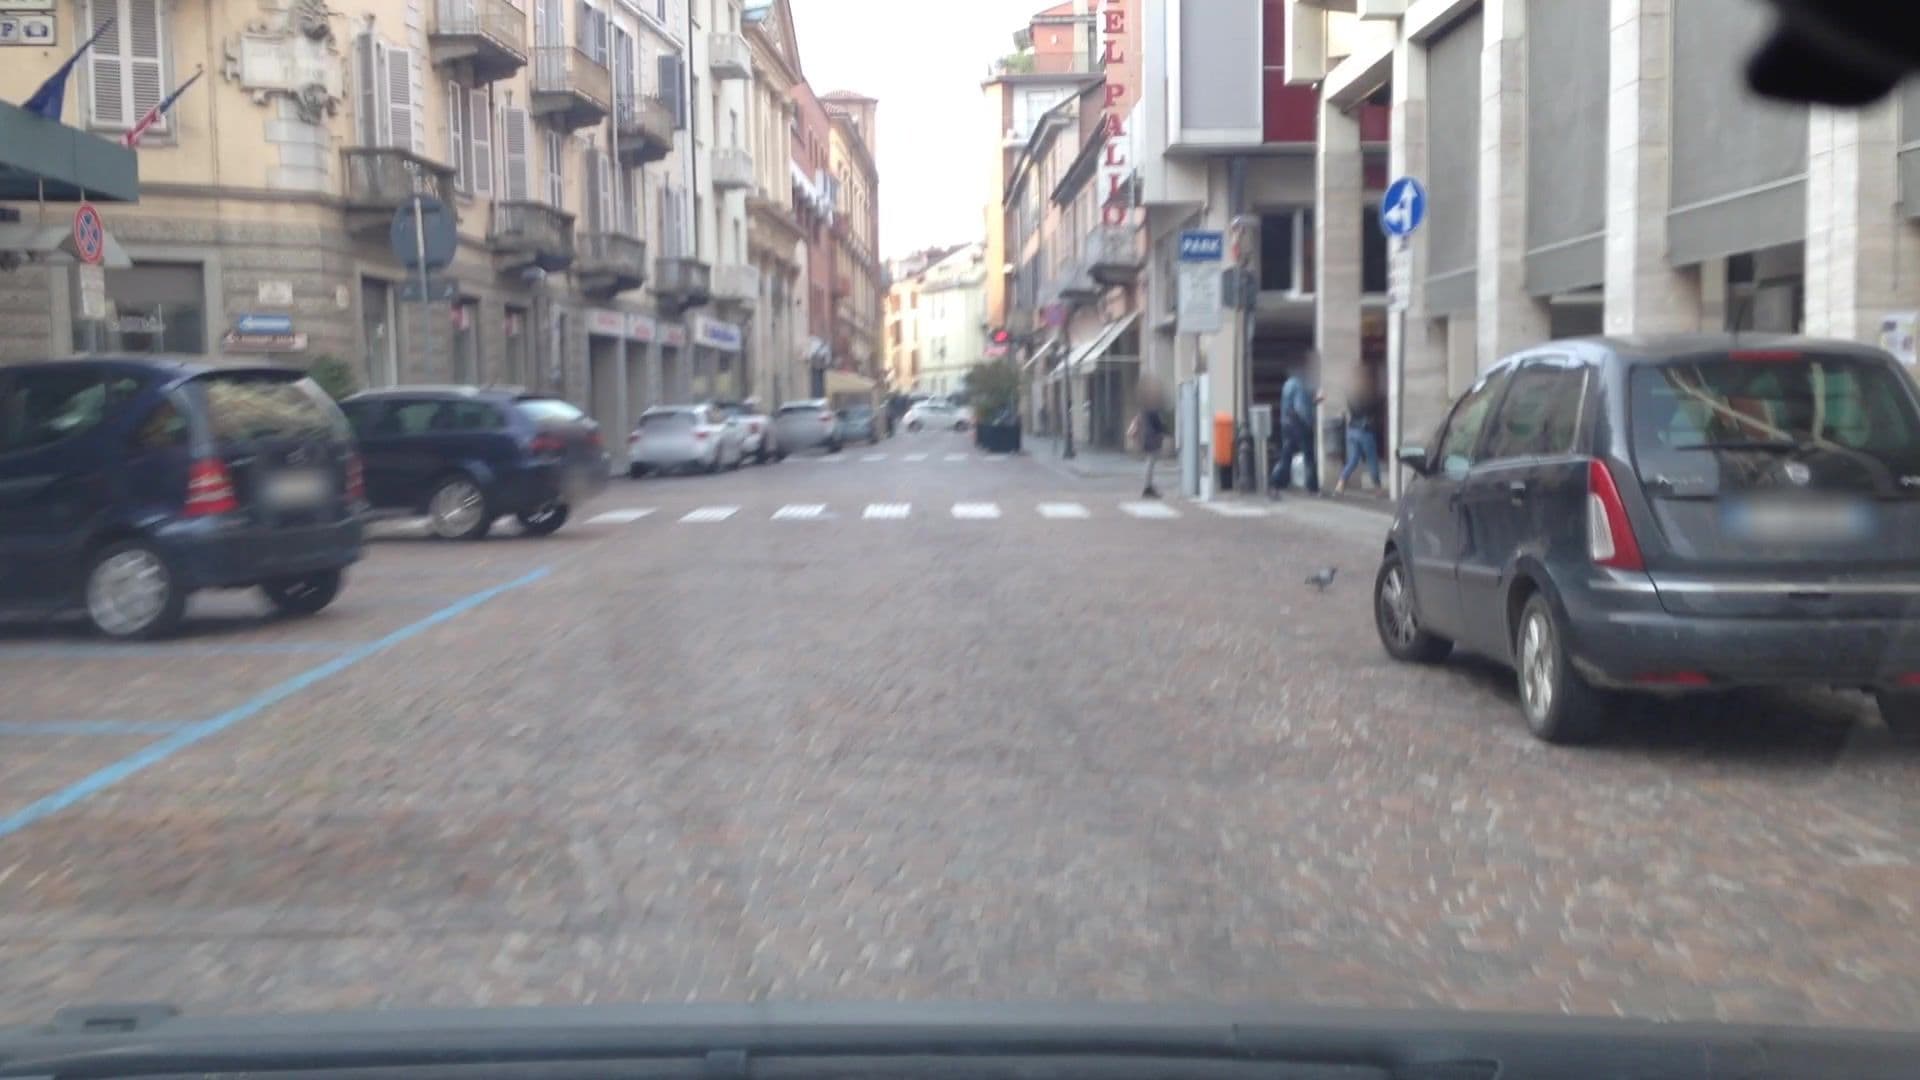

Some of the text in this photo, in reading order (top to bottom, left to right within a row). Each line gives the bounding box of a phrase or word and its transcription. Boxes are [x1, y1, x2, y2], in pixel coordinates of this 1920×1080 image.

[1102, 0, 1127, 226] EL PALIO
[1182, 237, 1219, 252] PARK
